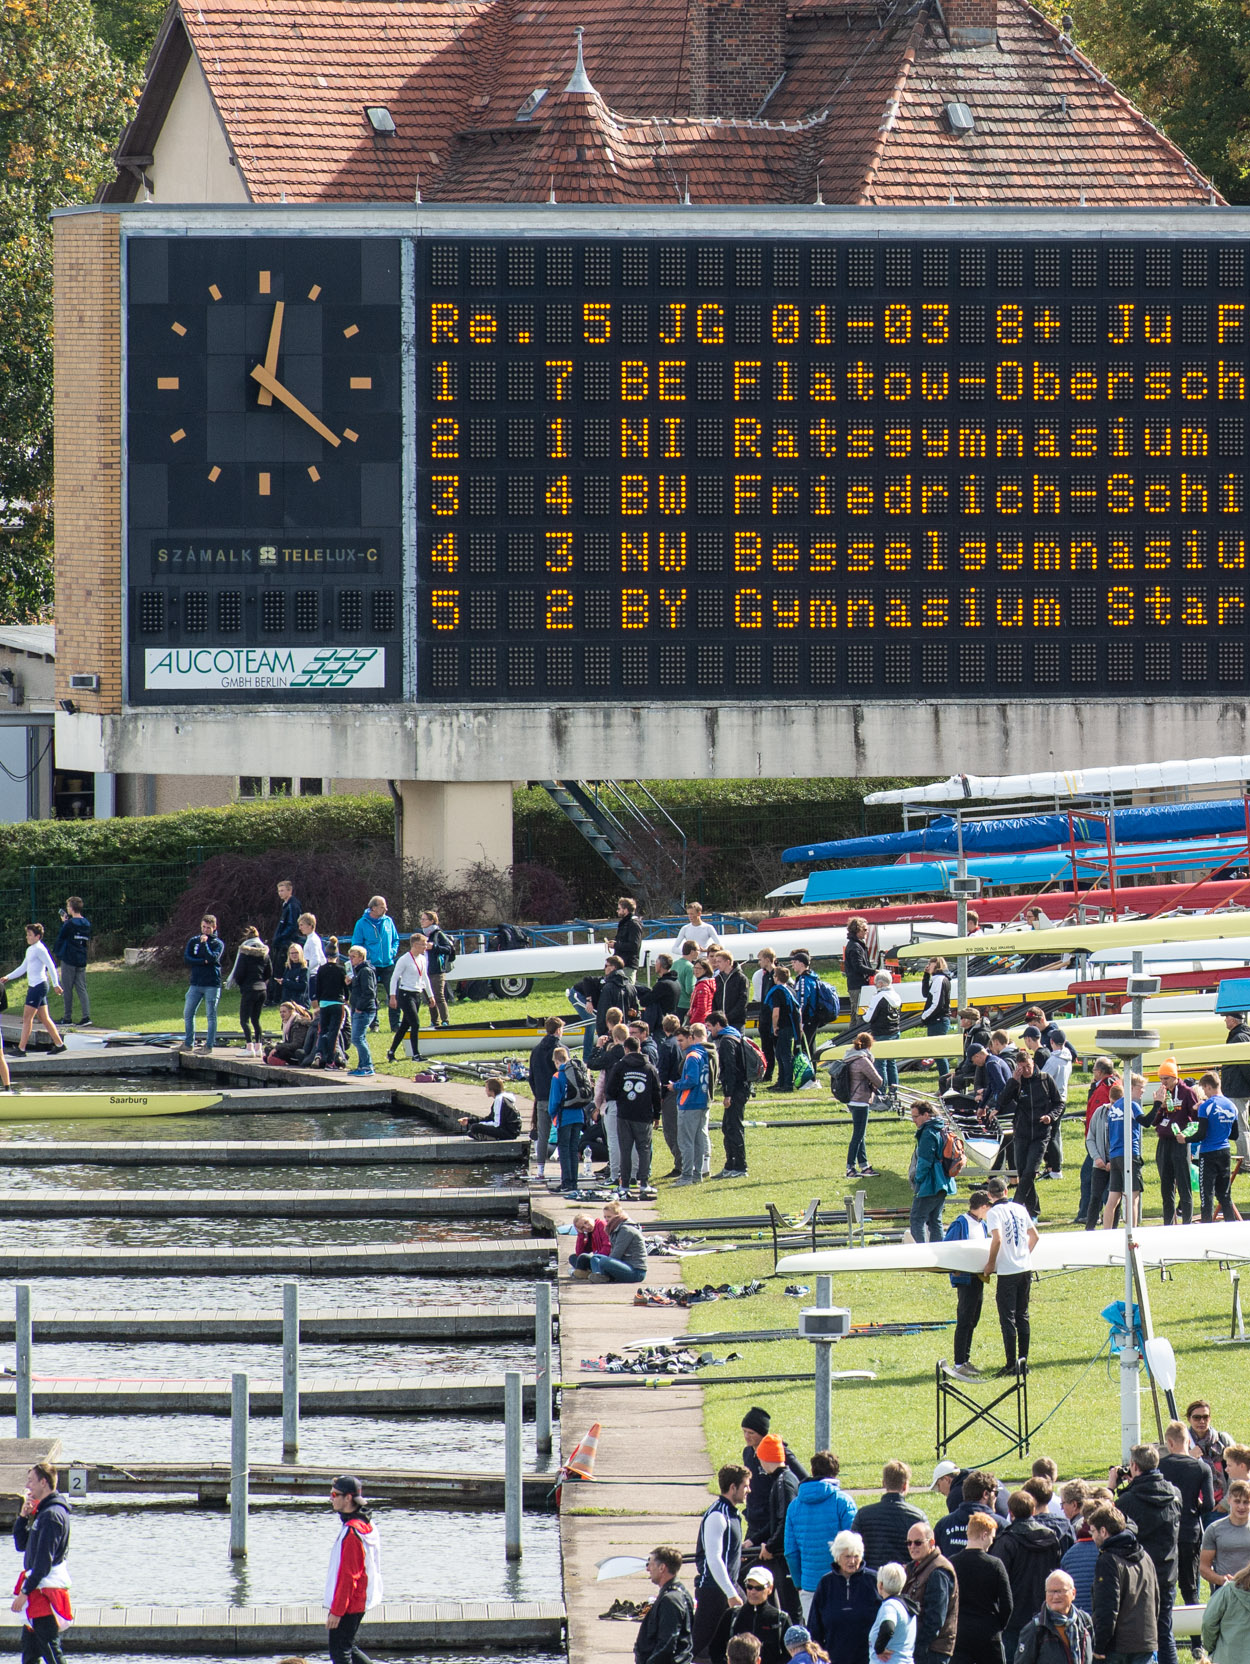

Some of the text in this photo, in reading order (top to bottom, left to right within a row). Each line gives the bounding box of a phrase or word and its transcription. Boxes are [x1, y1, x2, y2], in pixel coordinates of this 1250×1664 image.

[431, 303, 530, 344] Re.
[583, 303, 611, 344] 5
[658, 303, 724, 344] JG
[771, 303, 949, 345] 01-03
[996, 304, 1061, 344] 8+
[1107, 304, 1172, 344] Ju
[436, 360, 454, 401] 1
[545, 360, 573, 401] 7
[621, 360, 687, 401] BE
[733, 360, 1245, 401] Flatow-Obersch
[431, 417, 460, 459] 2
[550, 417, 567, 458] 1
[621, 417, 681, 458] NI
[734, 416, 1209, 458] Ratsgymnasium
[431, 475, 459, 516] 3
[545, 474, 573, 515] 4
[621, 474, 687, 515] BW
[734, 473, 1240, 515] Friedrich-Schi
[158, 546, 378, 562] SZÁMALK TELELUX-C
[431, 532, 459, 573] 4
[545, 532, 573, 573] 3
[621, 531, 687, 572] NW
[734, 529, 1245, 572] Besselgymnasiu
[431, 589, 460, 630] 5
[545, 589, 574, 630] 2
[621, 588, 687, 629] BY
[734, 587, 1061, 629] Gymnasium
[1107, 585, 1245, 626] Star
[150, 649, 296, 674] AUCOTEAM
[221, 676, 287, 689] GMBH BERLIN
[109, 1096, 148, 1105] Saarburg
[73, 1477, 81, 1489] 2
[946, 1525, 968, 1535] Schul
[950, 1538, 968, 1546] HAMB
